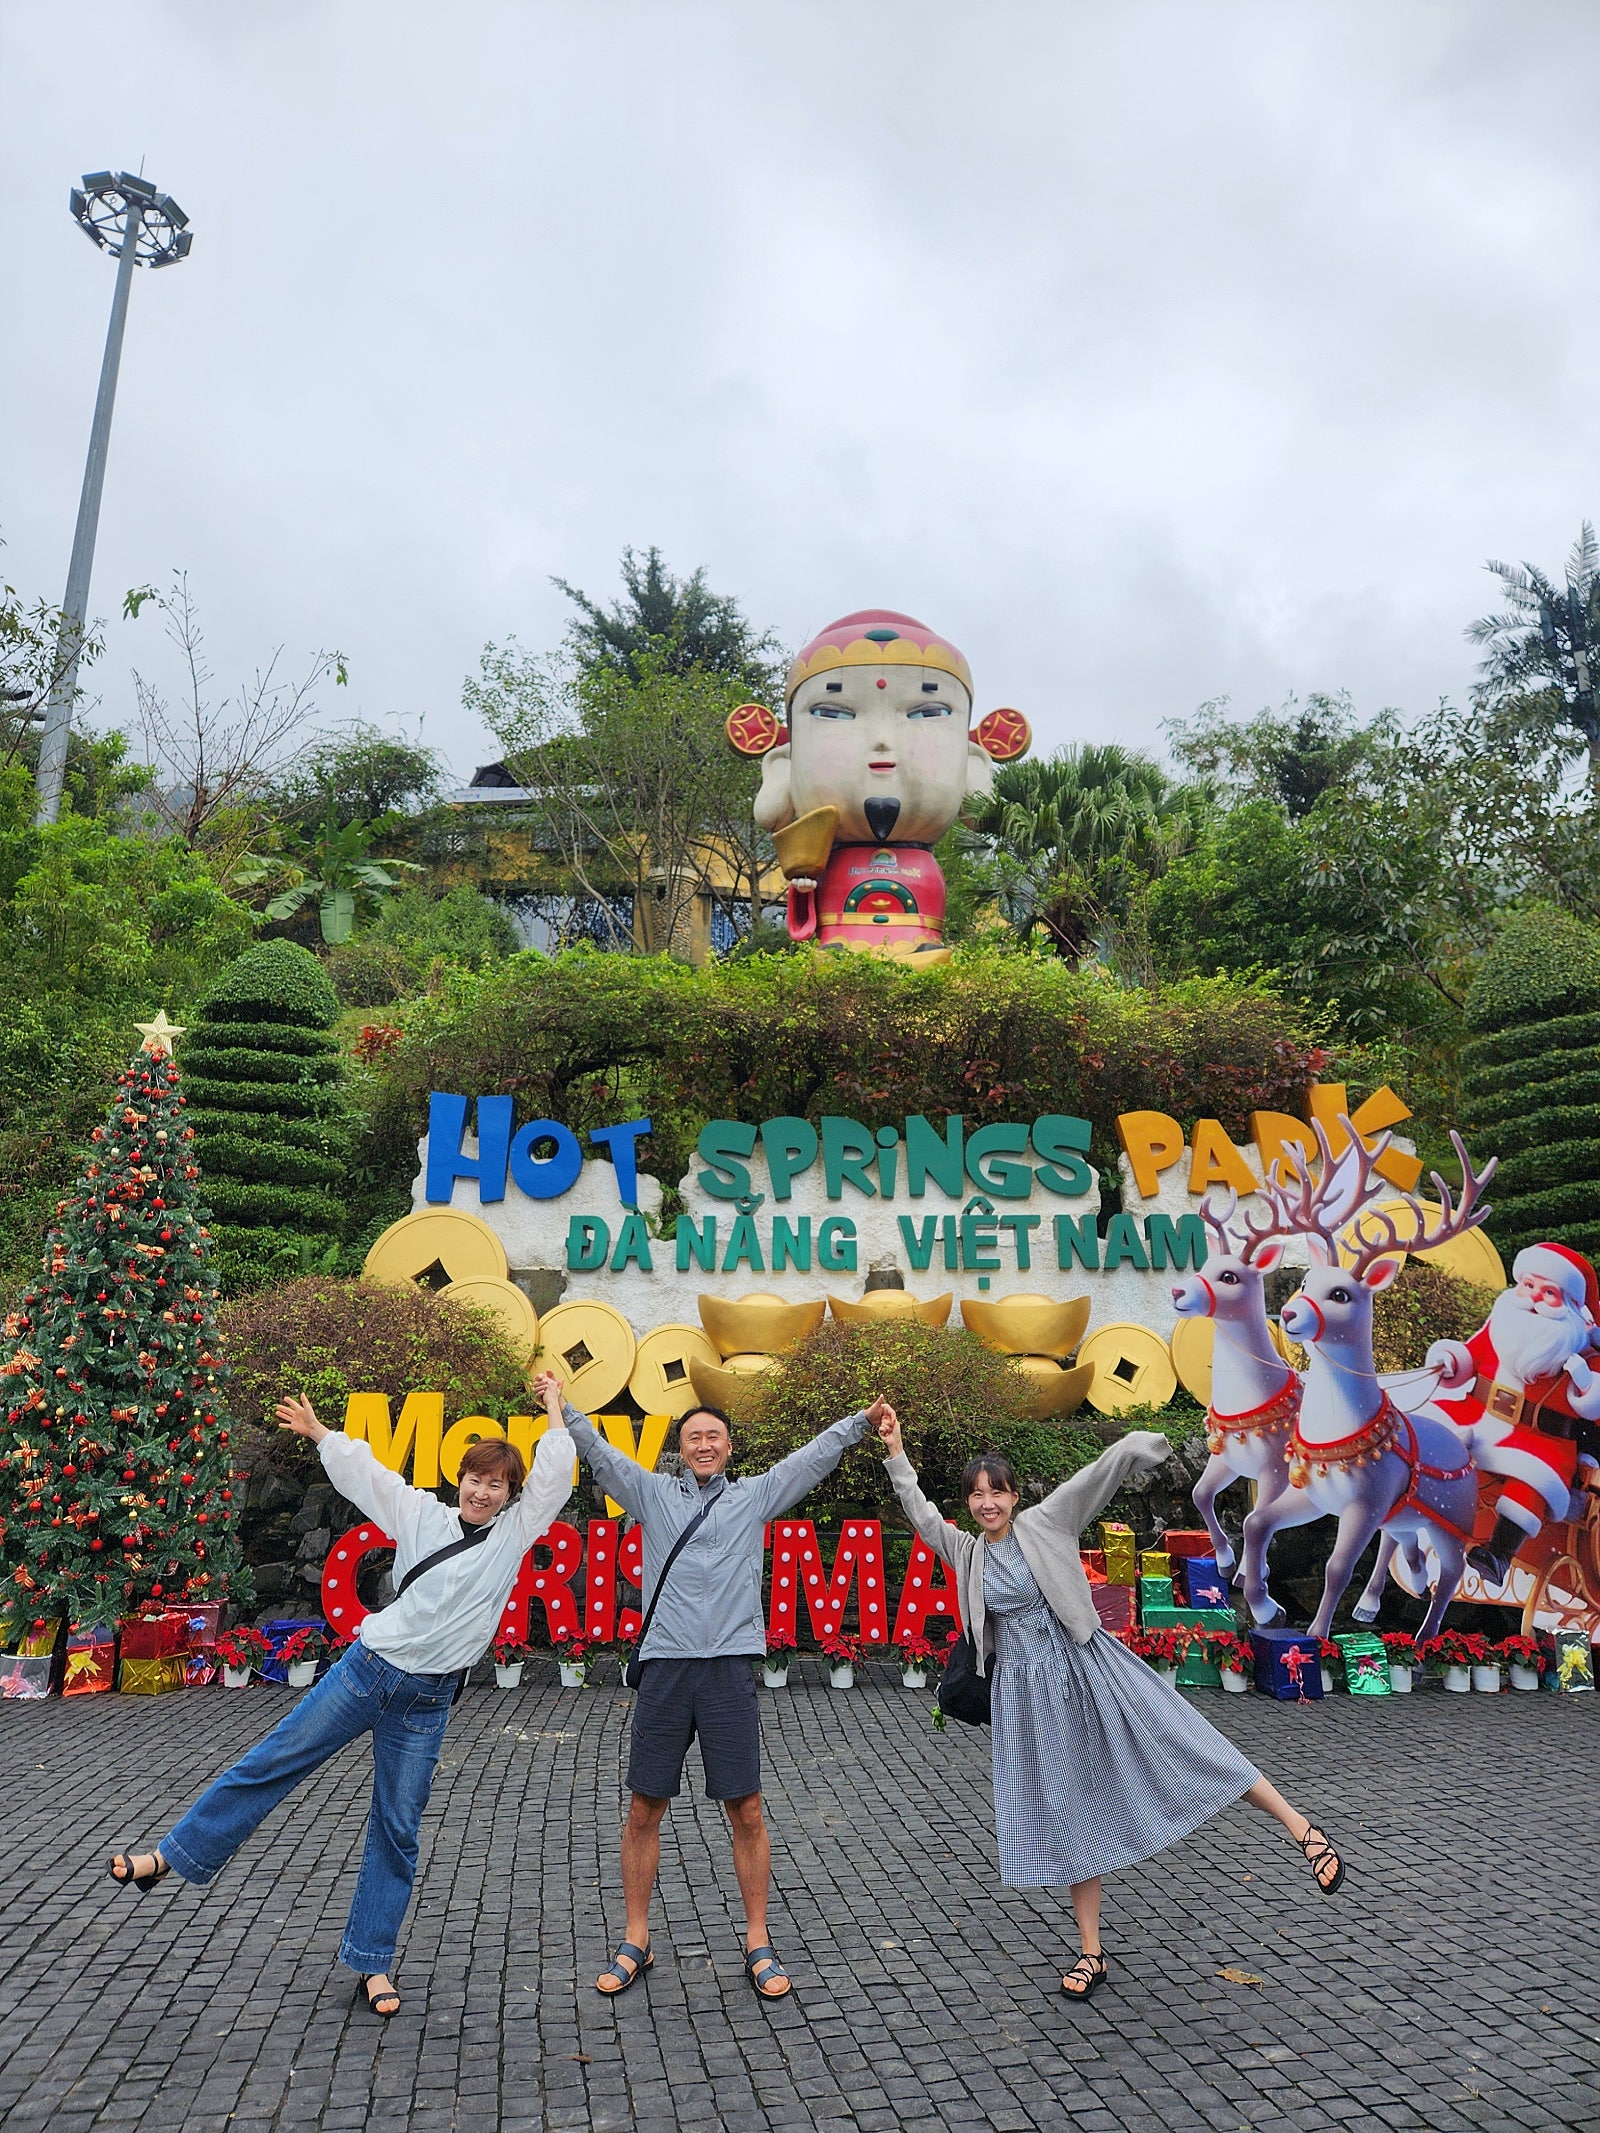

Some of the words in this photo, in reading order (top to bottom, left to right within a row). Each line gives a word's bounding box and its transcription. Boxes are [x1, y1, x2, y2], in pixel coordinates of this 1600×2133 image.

[425, 1091, 653, 1205] HOT
[1115, 1082, 1425, 1198] PARK
[897, 1196, 1041, 1290] VIỆT
[1053, 1213, 1209, 1271] NAM
